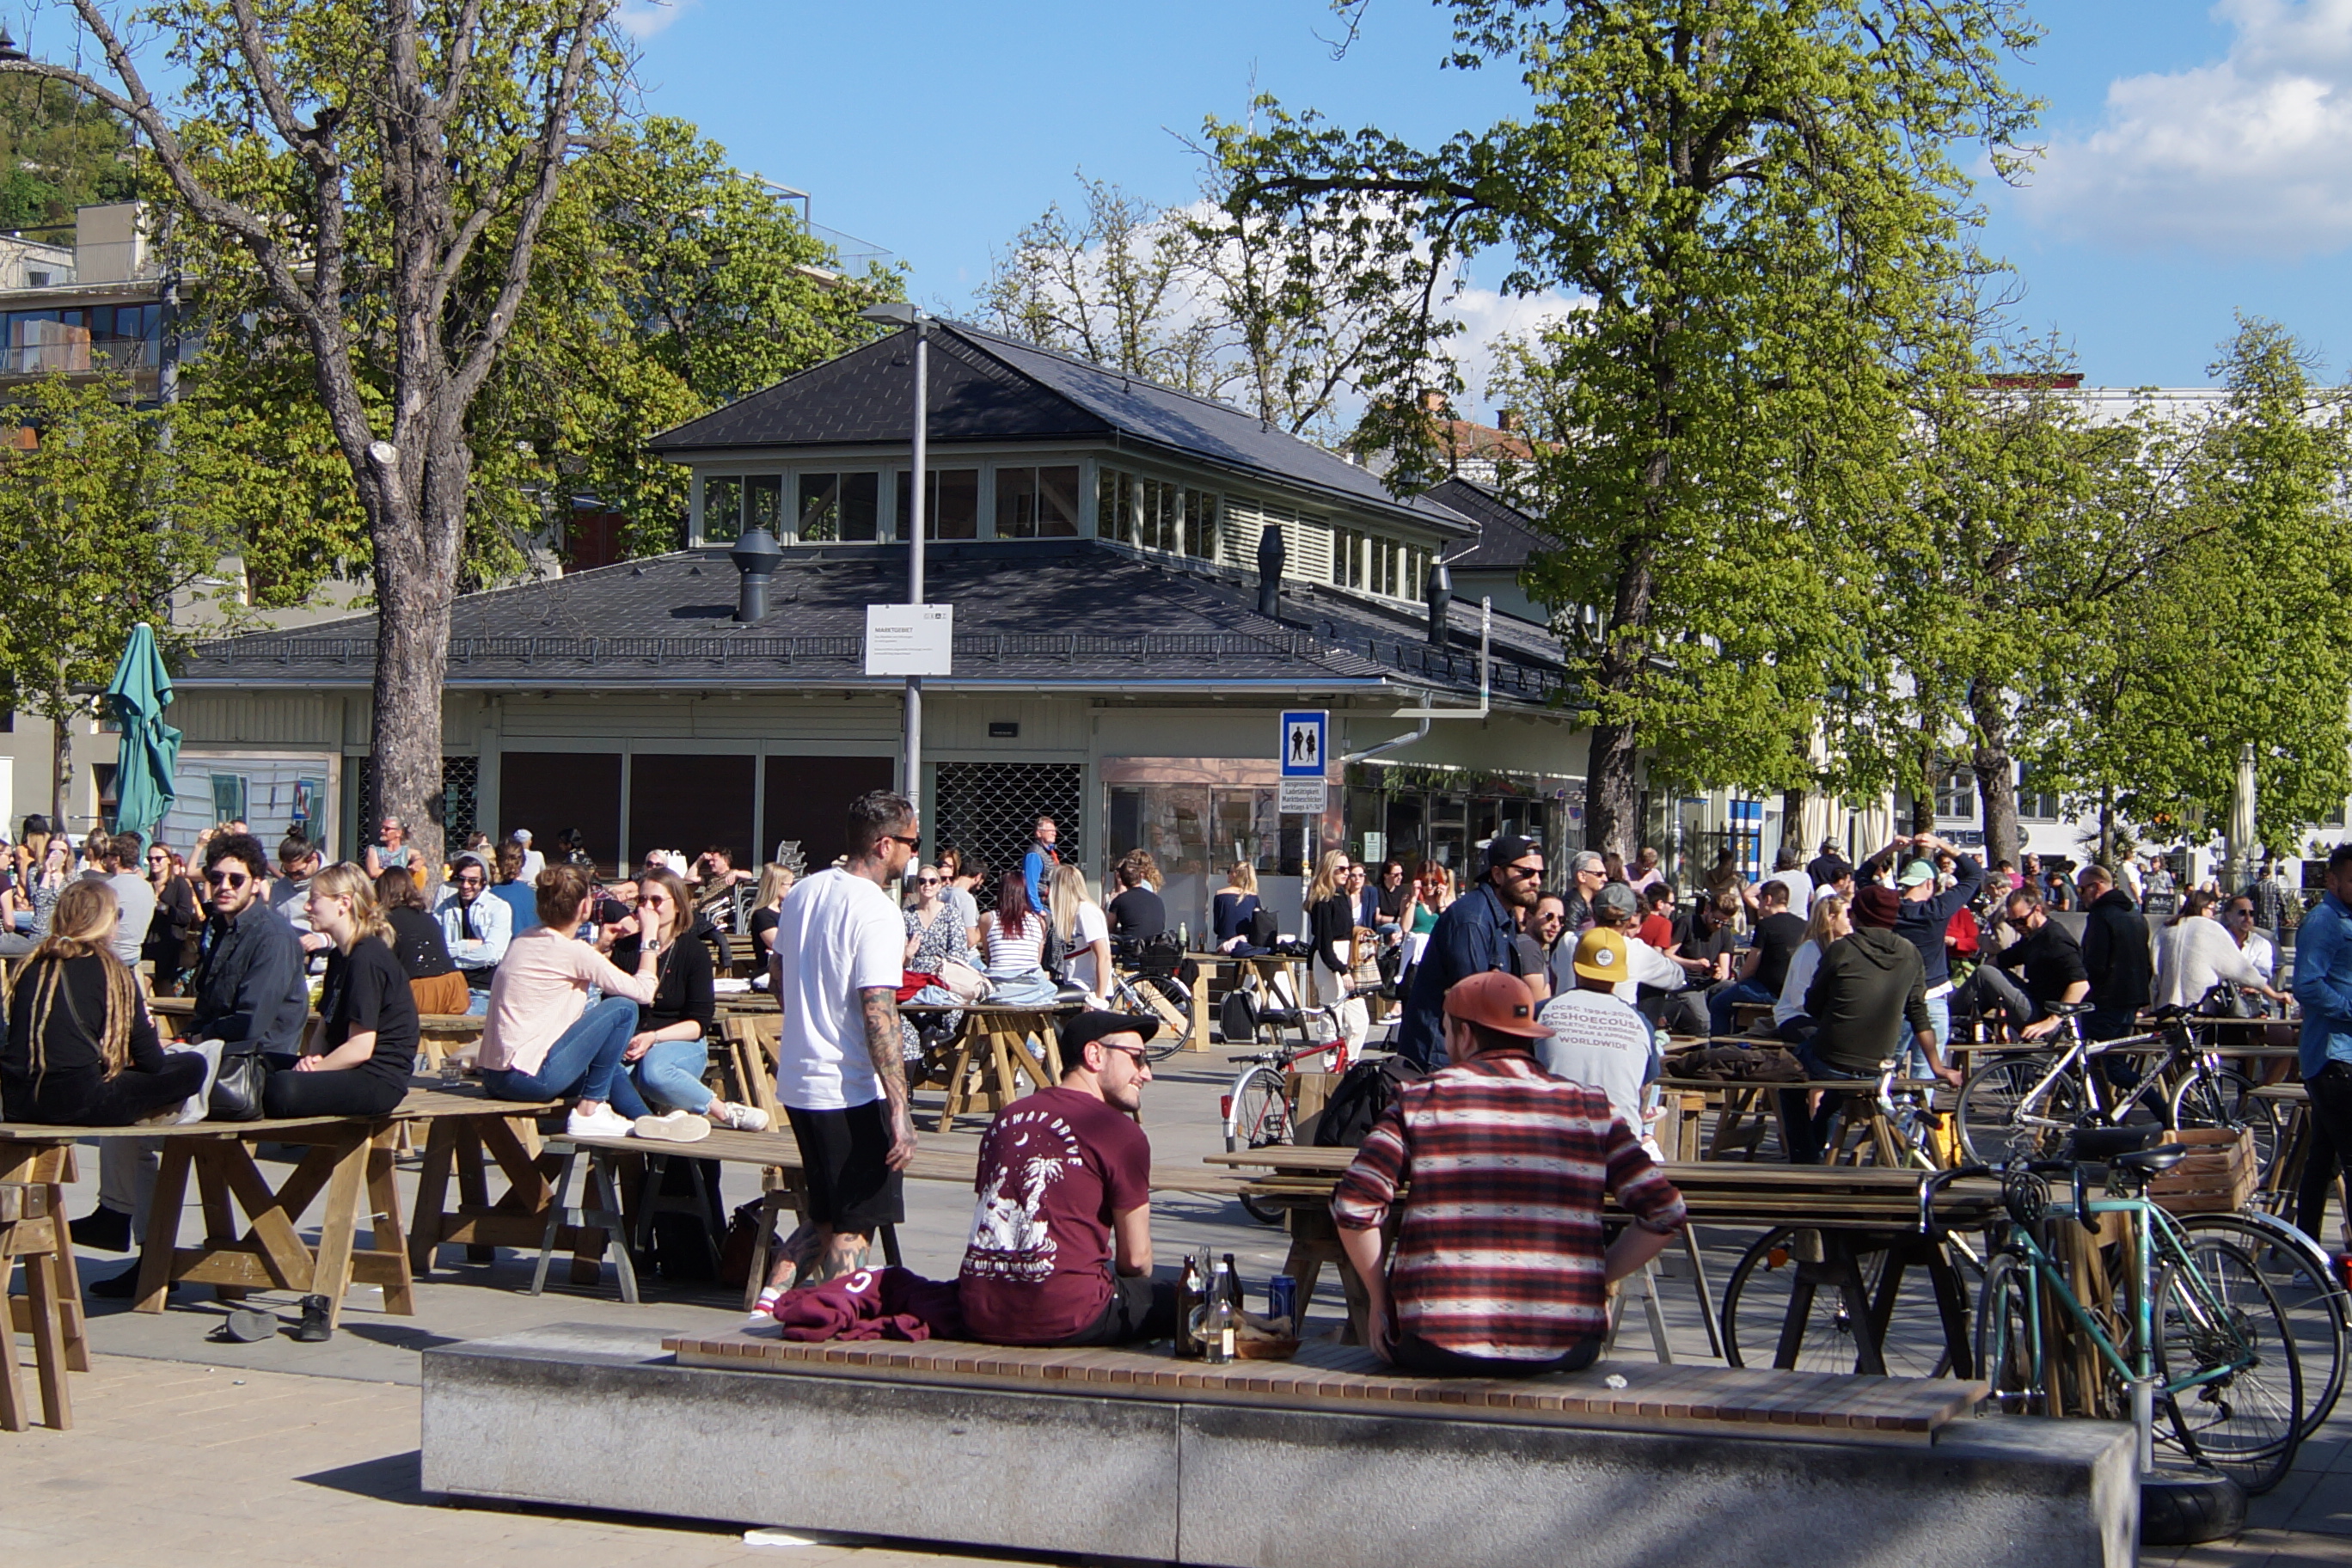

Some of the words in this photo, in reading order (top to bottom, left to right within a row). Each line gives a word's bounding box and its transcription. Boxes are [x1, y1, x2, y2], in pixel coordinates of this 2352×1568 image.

[1541, 1012, 1644, 1032] DCSHOECOUSA
[1547, 1020, 1585, 1029] ATHLETIC
[1559, 1036, 1628, 1050] WORLDWIDE
[1050, 1117, 1083, 1167] DRIVE
